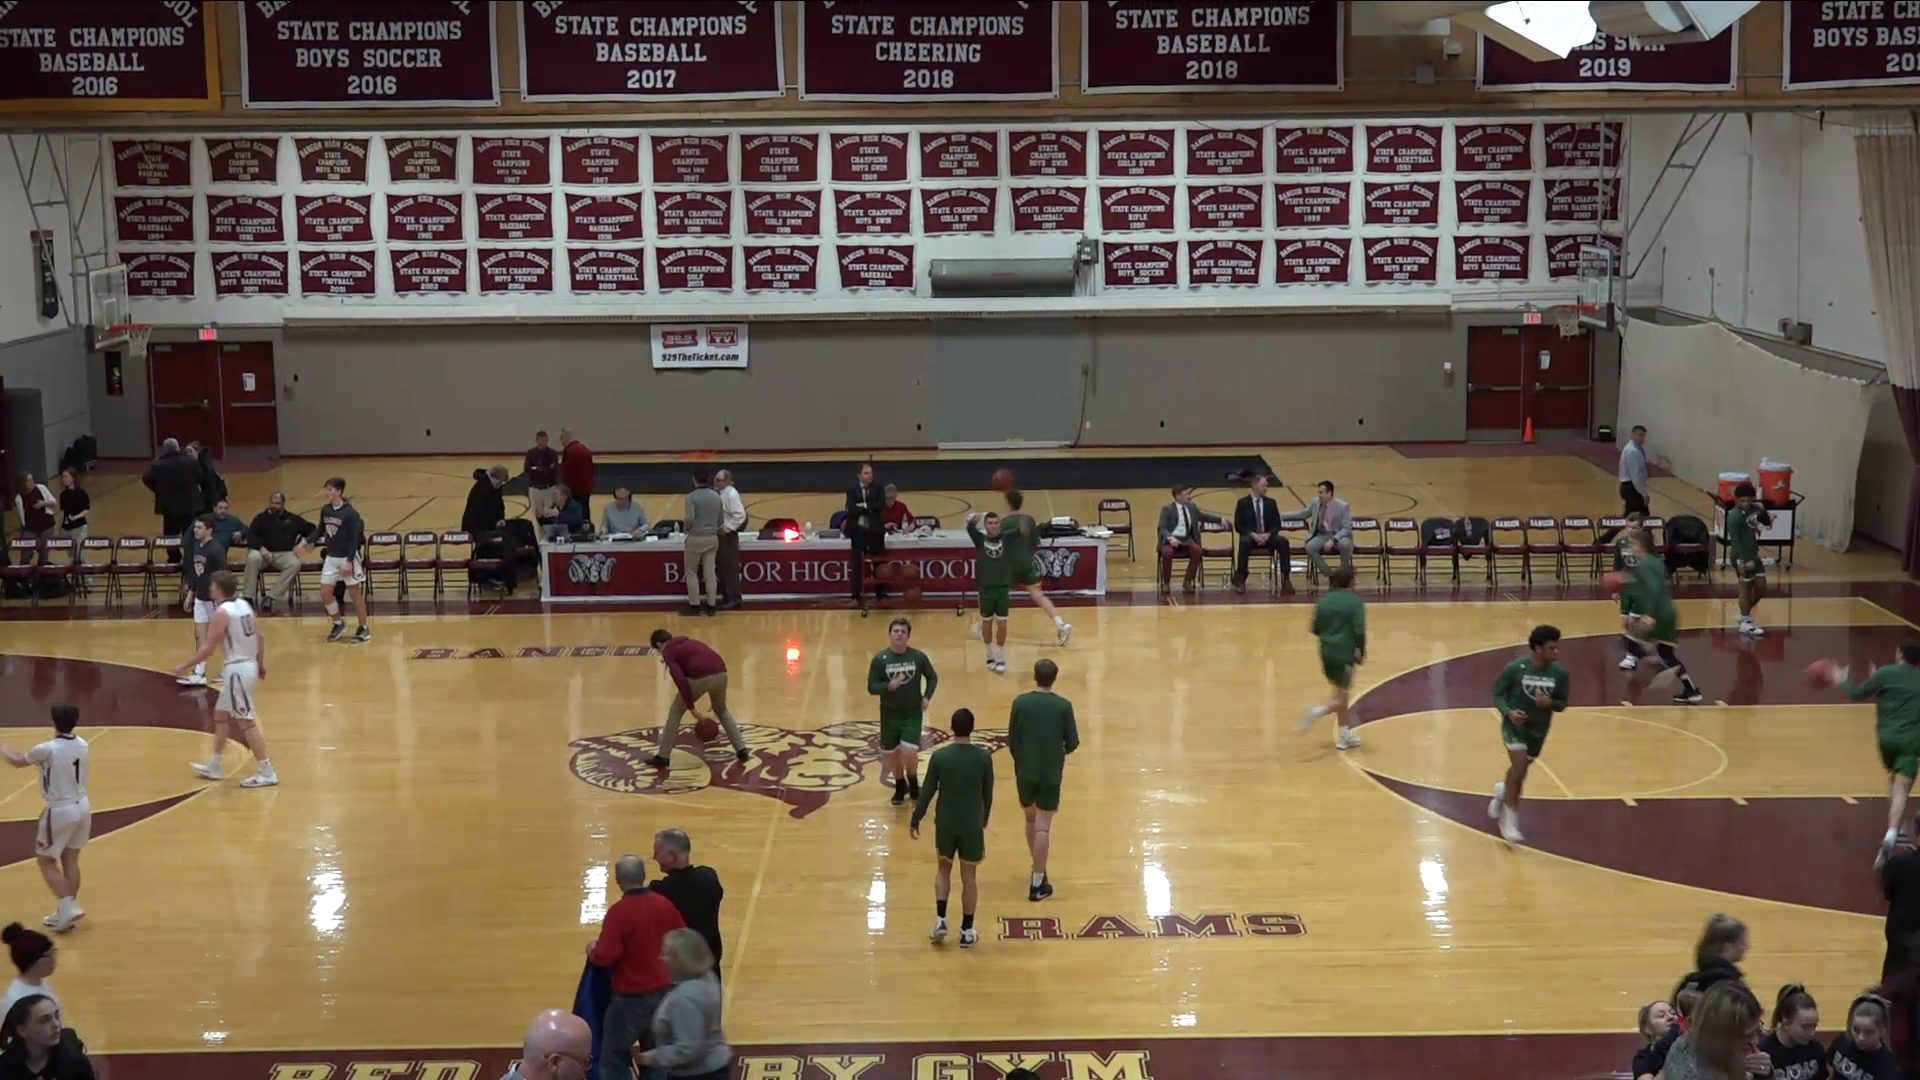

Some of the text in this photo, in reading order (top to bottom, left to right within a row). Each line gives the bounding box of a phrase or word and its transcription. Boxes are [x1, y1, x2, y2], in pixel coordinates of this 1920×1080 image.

[1116, 6, 1310, 29] STATE CHAMPIONS
[1821, 1, 1885, 20] STATE
[277, 20, 462, 41] STATE CHAMPIONS
[555, 15, 747, 36] STATE CHAMPIONS
[831, 15, 1024, 36] STATE CHAMPIONS
[69, 27, 185, 46] CHAMPIONS
[1157, 34, 1270, 54] BASEBALL
[1813, 27, 1868, 47] BOYS
[296, 48, 442, 68] BOYS SOCCER
[596, 42, 707, 62] BASEBALL
[875, 42, 981, 62] CHEERING
[39, 53, 145, 72] BASEBALL
[1186, 60, 1239, 80] 2018
[1579, 57, 1632, 77] 2019
[72, 76, 118, 95] 2016
[347, 75, 397, 95] 2016
[627, 70, 676, 89] 2017
[903, 69, 954, 88] 2018
[662, 353, 739, 362] 929TheTicket.com
[664, 562, 783, 583] BOR
[408, 646, 658, 660] BANGO
[72, 757, 80, 784] 1
[998, 912, 1307, 940] RAMS
